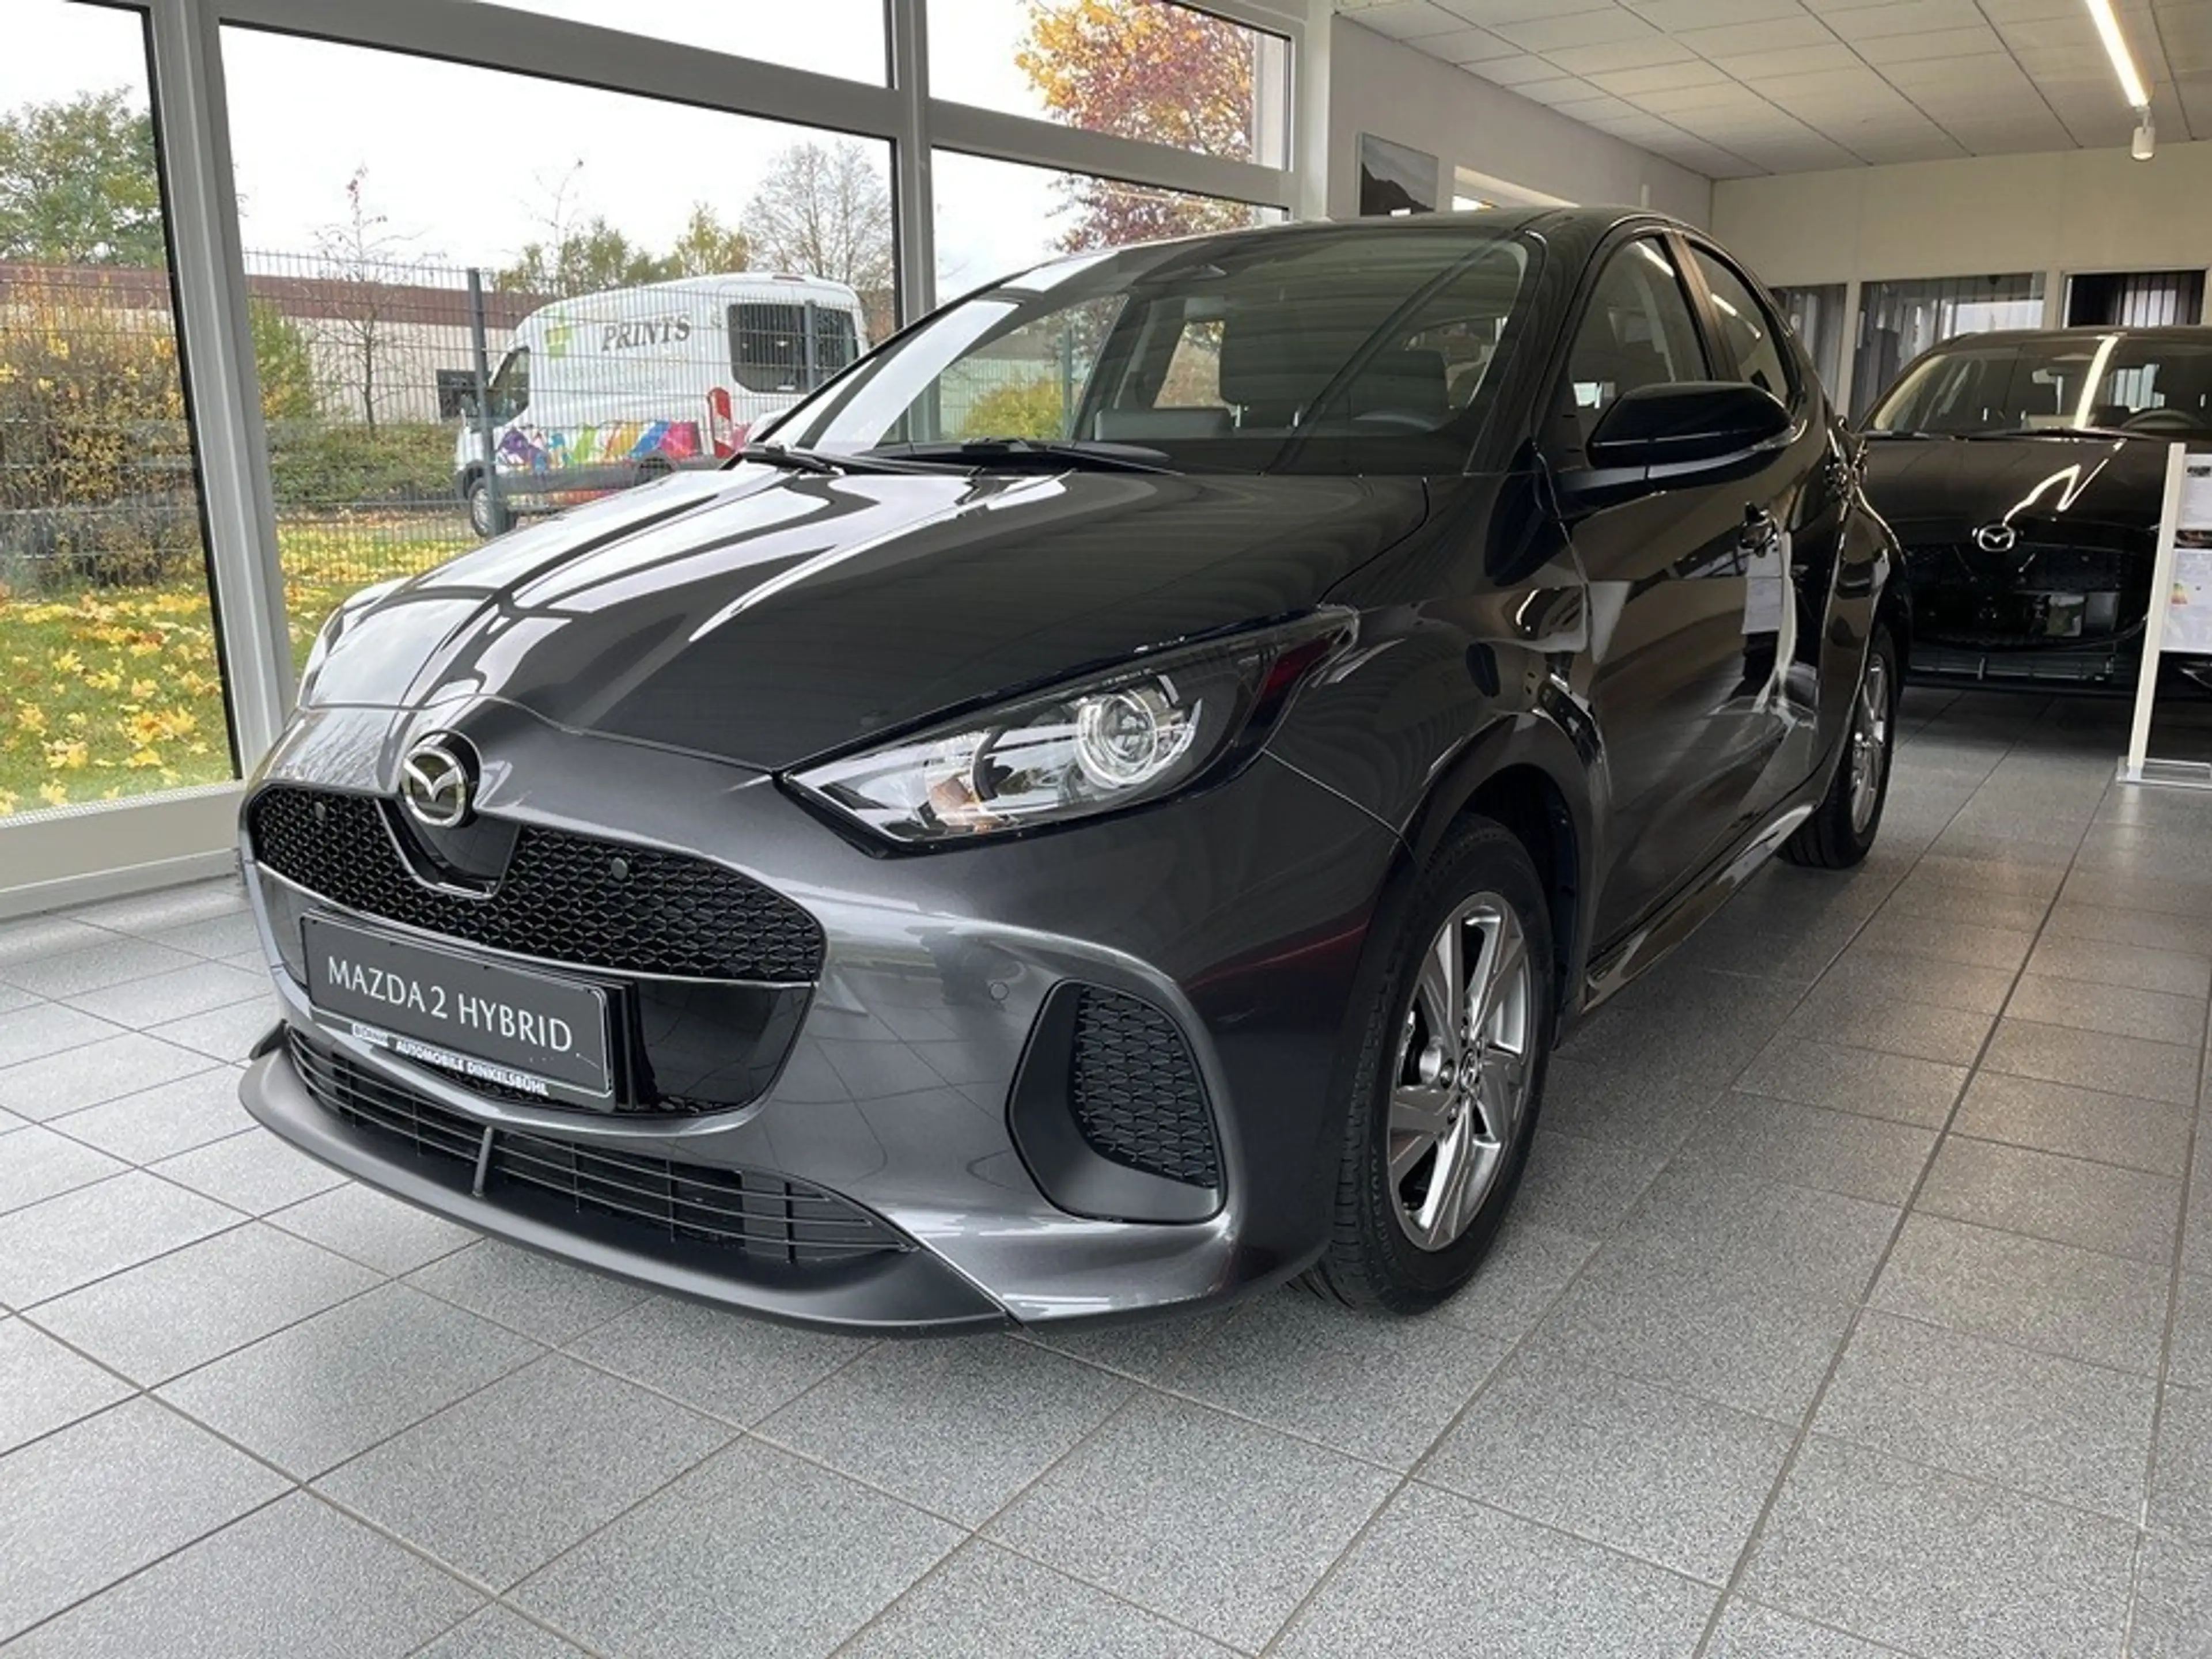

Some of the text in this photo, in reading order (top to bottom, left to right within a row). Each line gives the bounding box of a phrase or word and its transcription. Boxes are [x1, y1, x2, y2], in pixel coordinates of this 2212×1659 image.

[602, 315, 690, 351] PRINTS
[329, 956, 572, 1052] MAZDA 2 HYBRID
